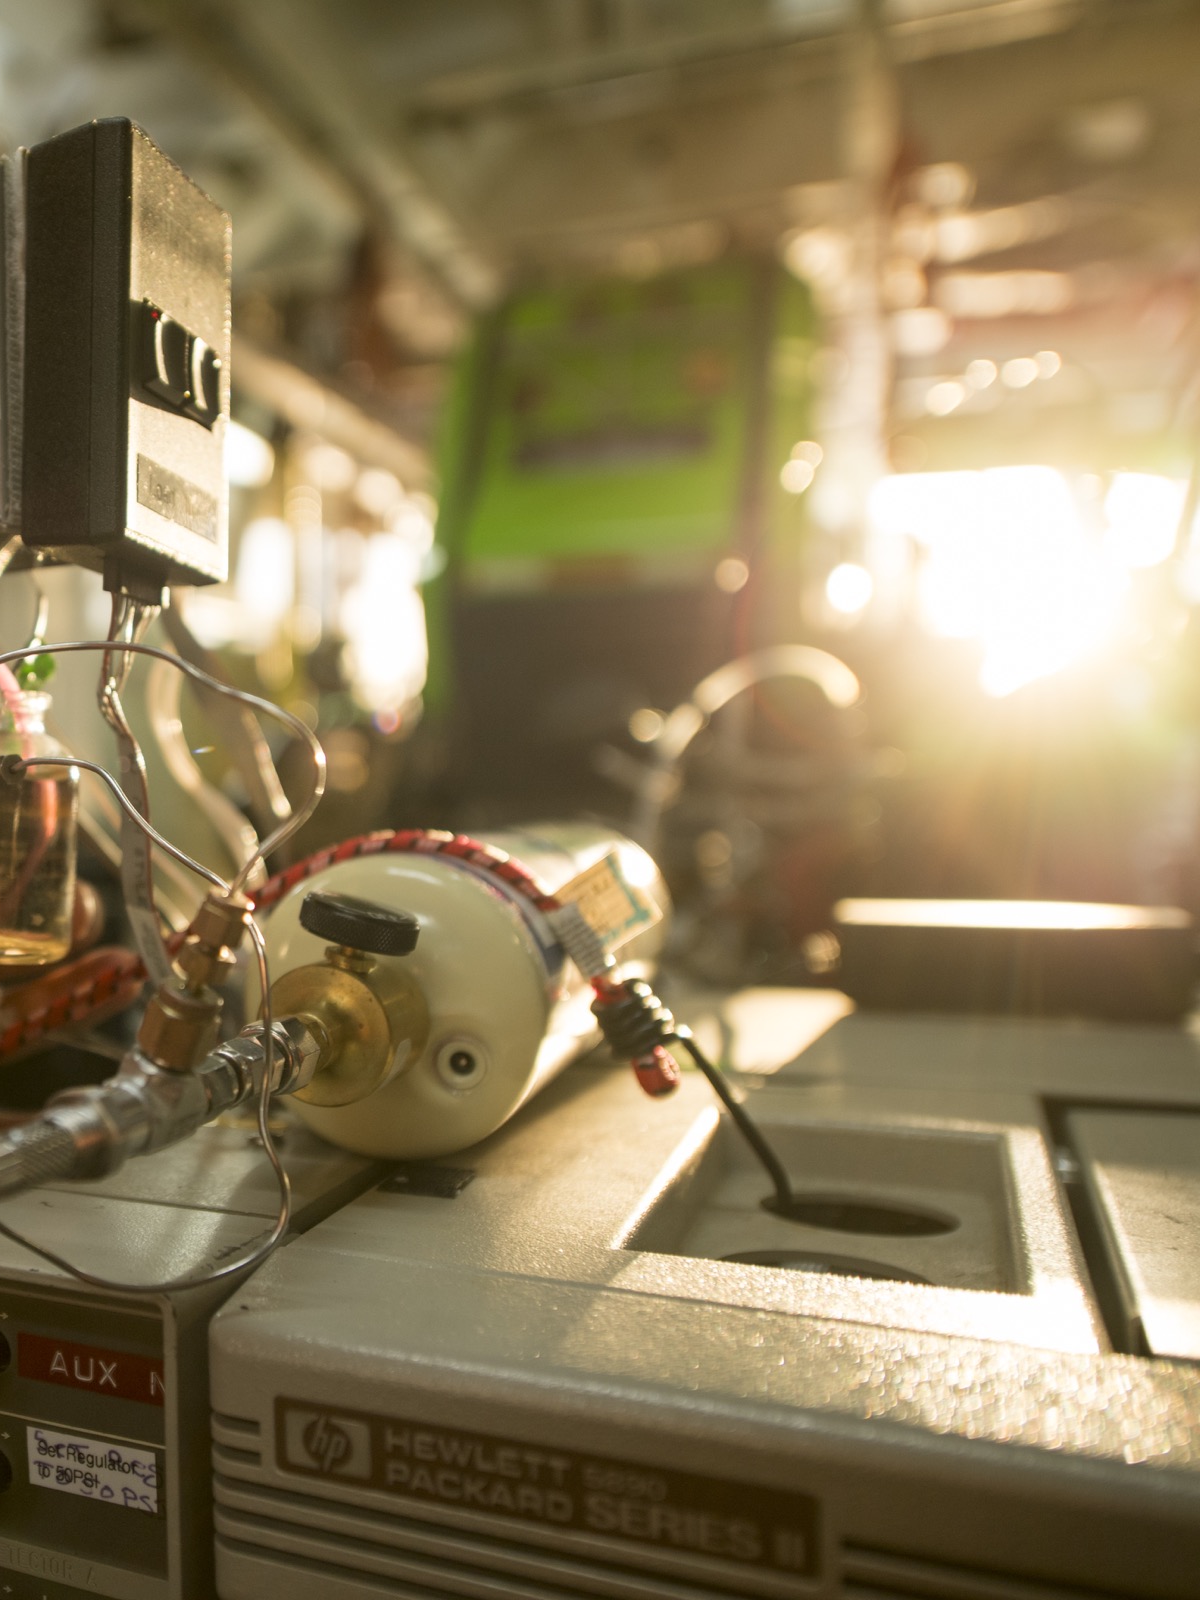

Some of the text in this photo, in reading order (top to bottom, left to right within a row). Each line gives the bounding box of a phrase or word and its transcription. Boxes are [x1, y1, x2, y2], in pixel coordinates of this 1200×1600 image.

[50, 1351, 118, 1388] AUX
[66, 1446, 137, 1475] Regulator
[310, 1414, 347, 1471] hp
[384, 1427, 573, 1482] HEWLETT
[385, 1460, 574, 1523] PACKARD
[584, 1496, 763, 1559] SERIES
